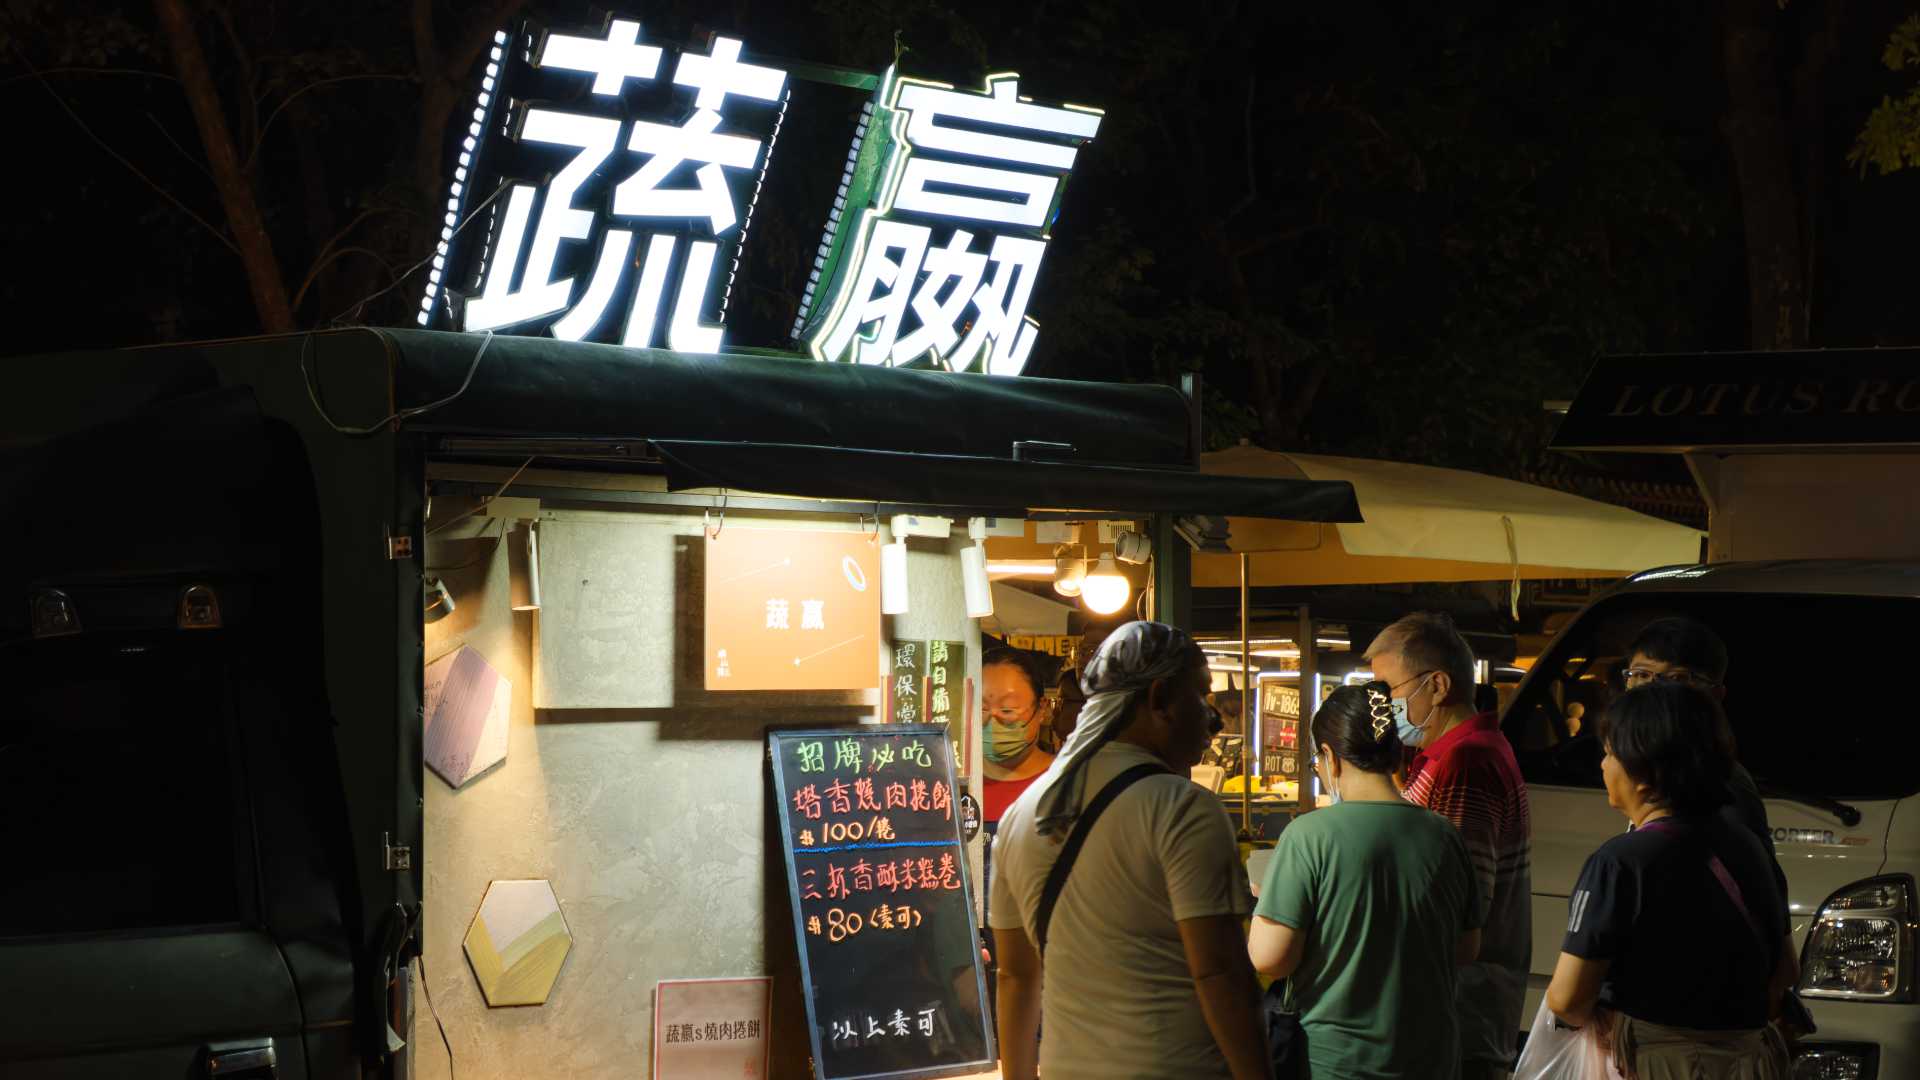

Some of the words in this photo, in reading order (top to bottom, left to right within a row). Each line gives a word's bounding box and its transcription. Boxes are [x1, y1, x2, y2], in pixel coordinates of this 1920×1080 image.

[1607, 383, 1824, 417] LOTUS
[796, 737, 932, 774] 招牌必吃
[1767, 827, 1834, 844] ORTER
[832, 1007, 936, 1042] 以上素可
